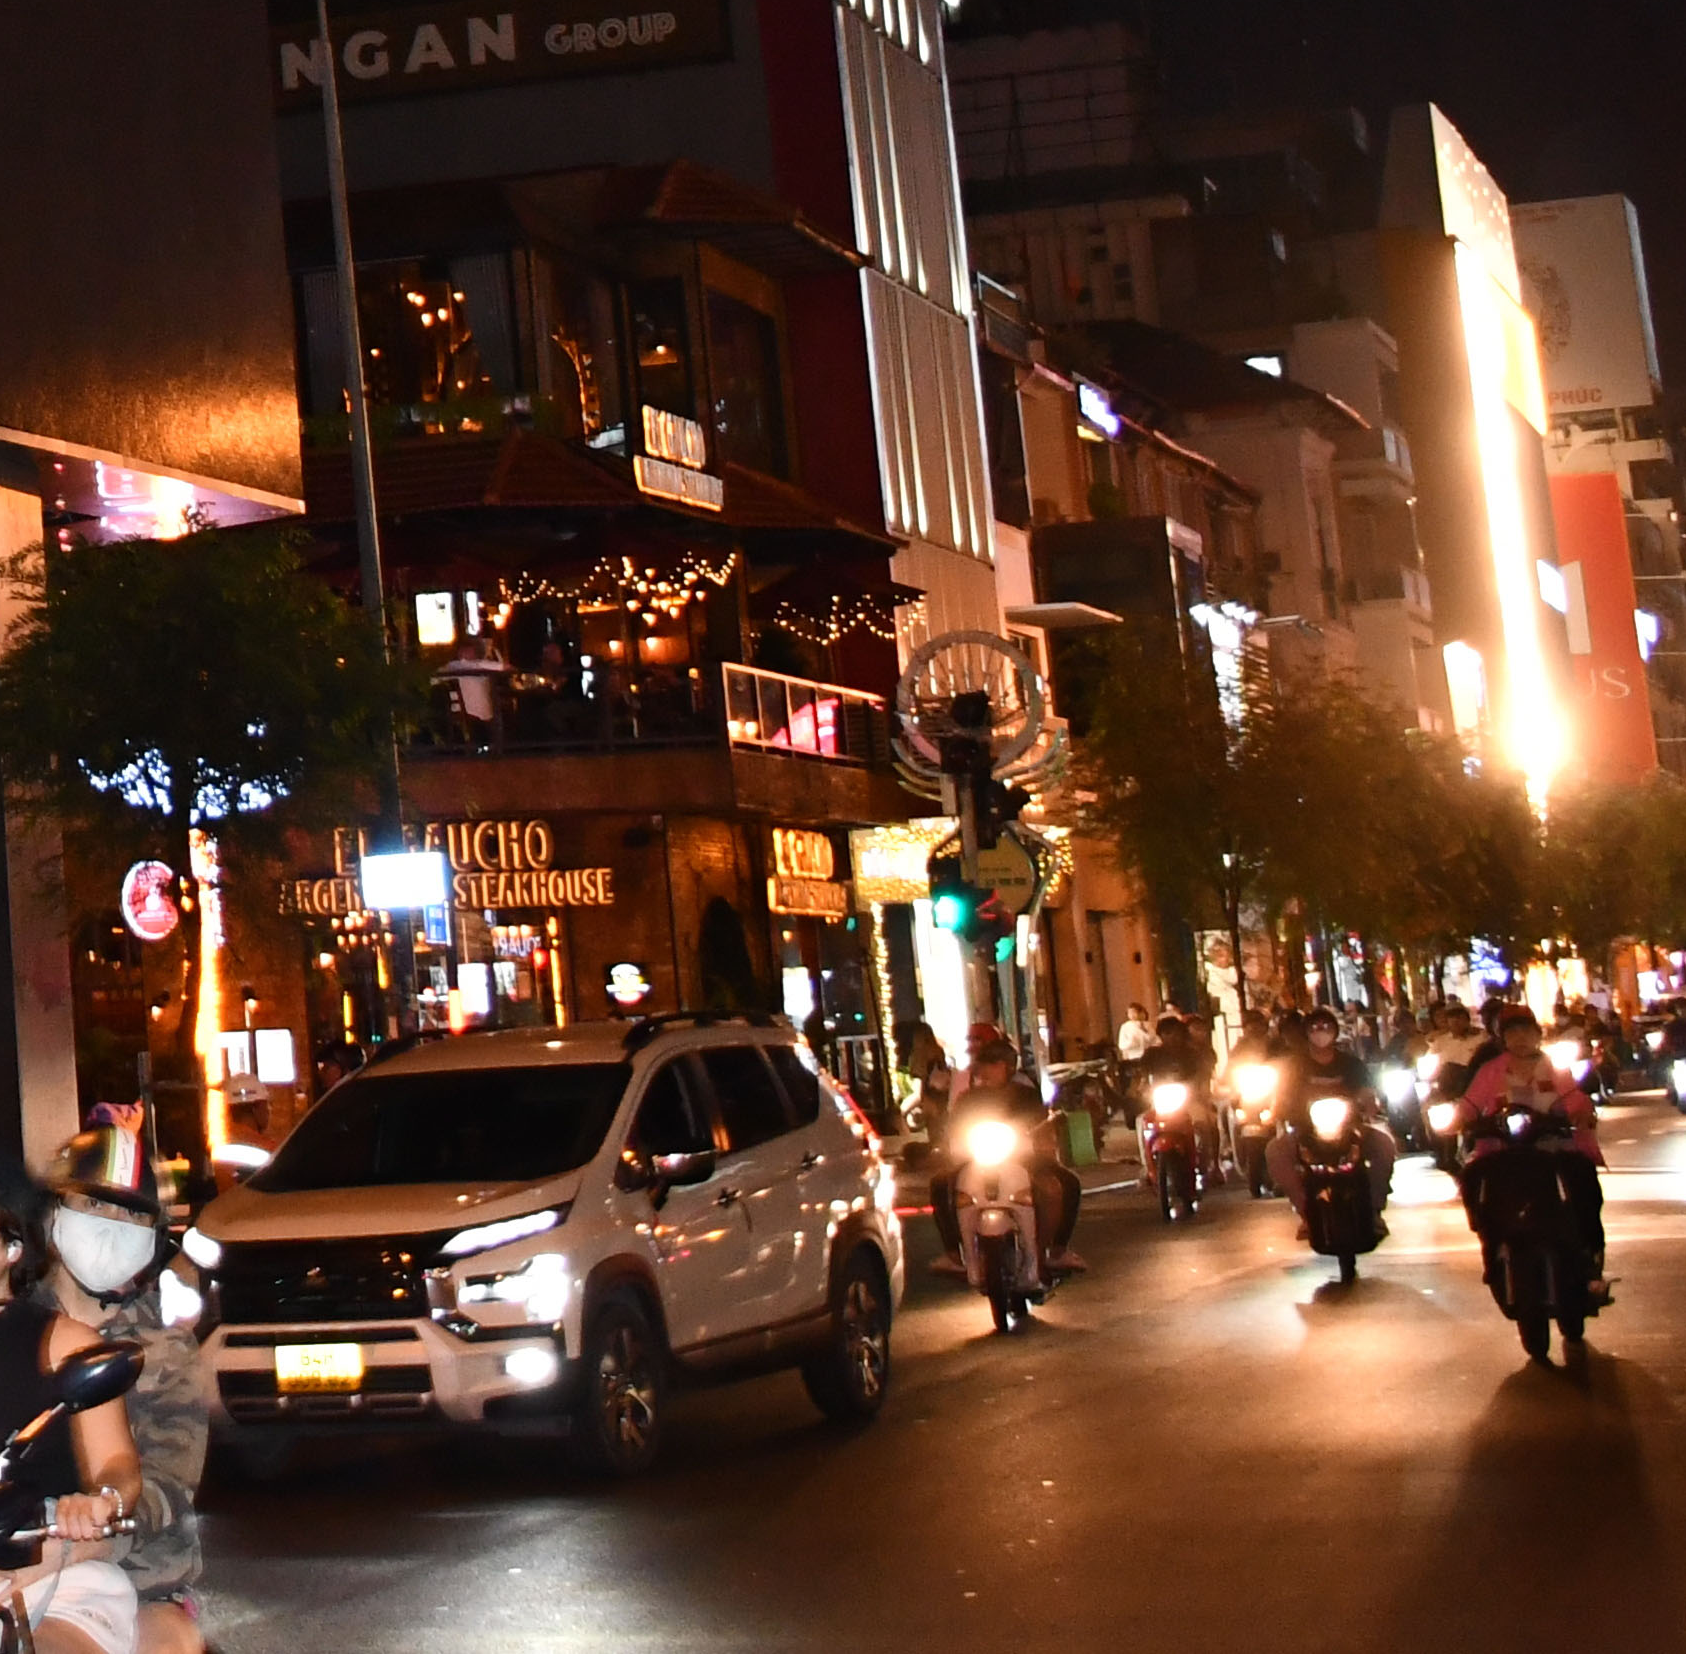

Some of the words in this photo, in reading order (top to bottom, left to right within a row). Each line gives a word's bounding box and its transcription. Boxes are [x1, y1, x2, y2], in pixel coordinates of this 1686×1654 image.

[279, 12, 517, 91] NGAN
[544, 12, 677, 55] GROUP
[402, 819, 553, 871] AUCHO
[453, 867, 614, 909] STEAKHOUSE
